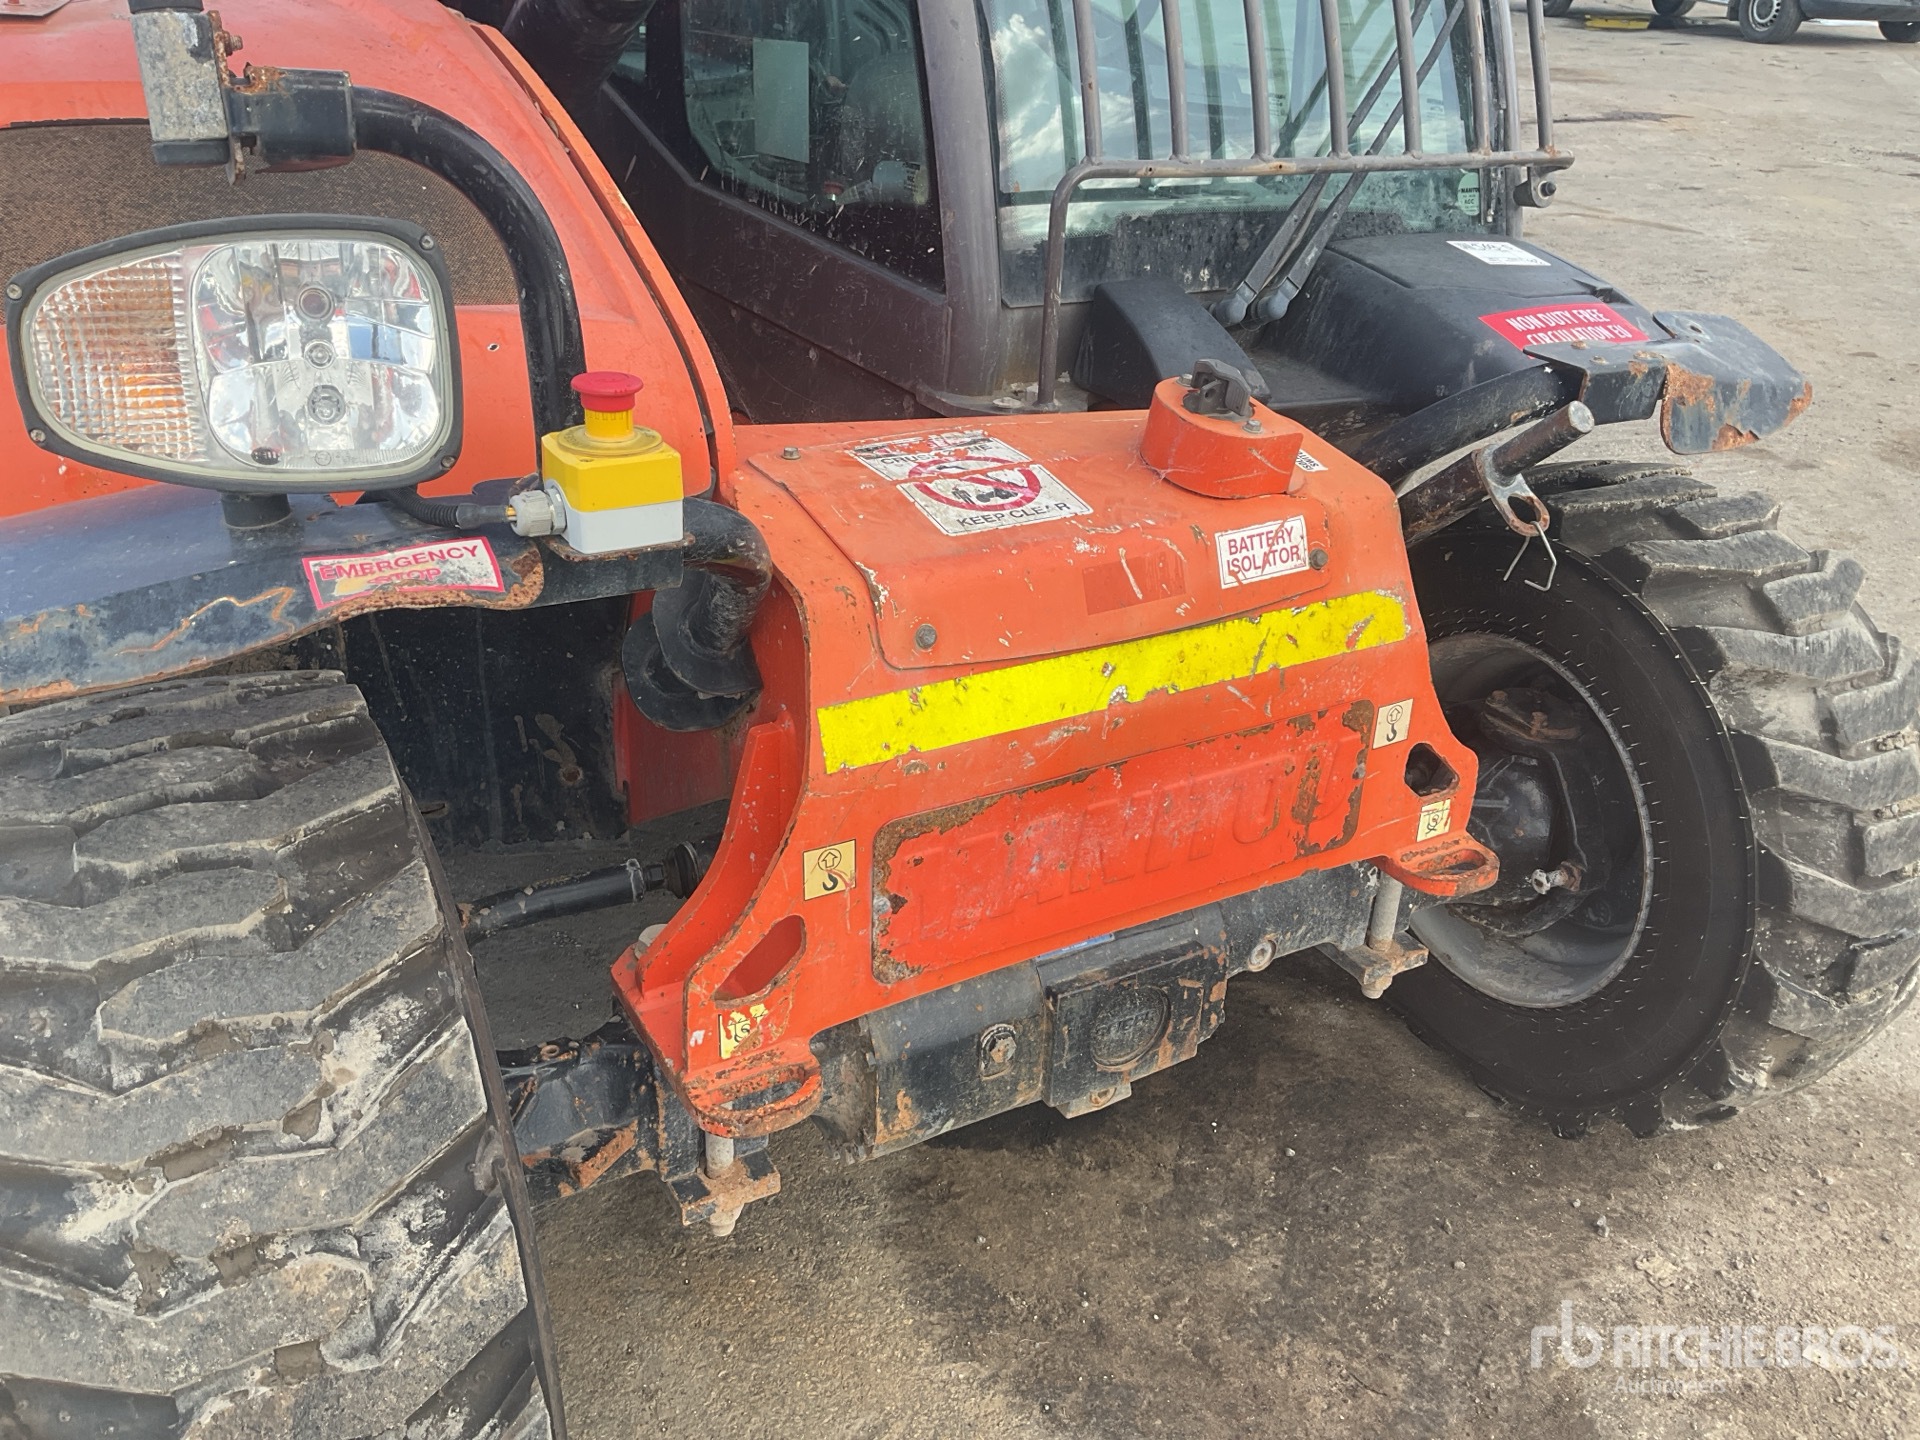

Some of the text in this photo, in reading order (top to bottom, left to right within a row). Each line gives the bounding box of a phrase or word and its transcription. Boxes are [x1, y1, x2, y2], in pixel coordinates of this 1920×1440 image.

[1505, 308, 1610, 332] NON DUTY FREE
[1526, 324, 1633, 345] CIRCULATION EU
[880, 453, 938, 466] CRUS
[957, 512, 1005, 527] KEEP
[1228, 526, 1294, 556] BATTERY
[319, 545, 478, 580] EMERGENCY
[1227, 545, 1300, 574] ISOLATOR
